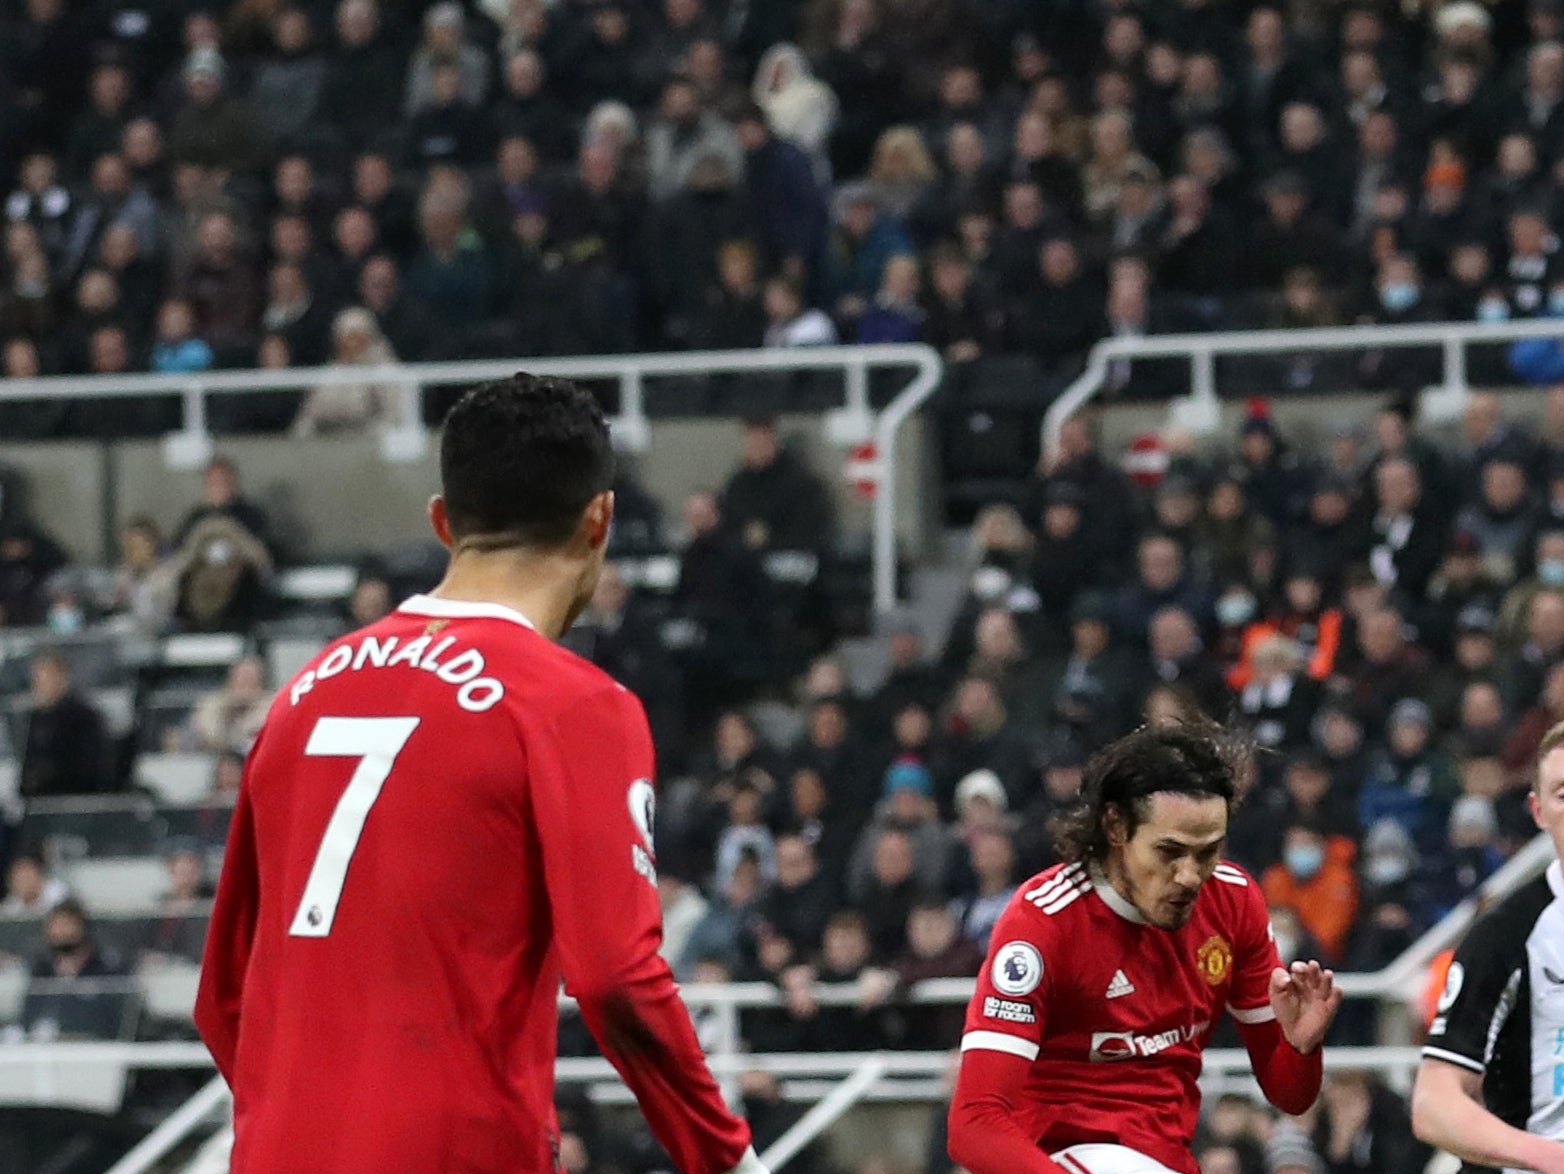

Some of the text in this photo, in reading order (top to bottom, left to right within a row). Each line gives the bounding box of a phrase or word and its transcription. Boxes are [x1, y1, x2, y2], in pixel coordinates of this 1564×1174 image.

[288, 635, 505, 712] RONALDO
[288, 716, 421, 938] 7
[1134, 1029, 1180, 1056] Team
